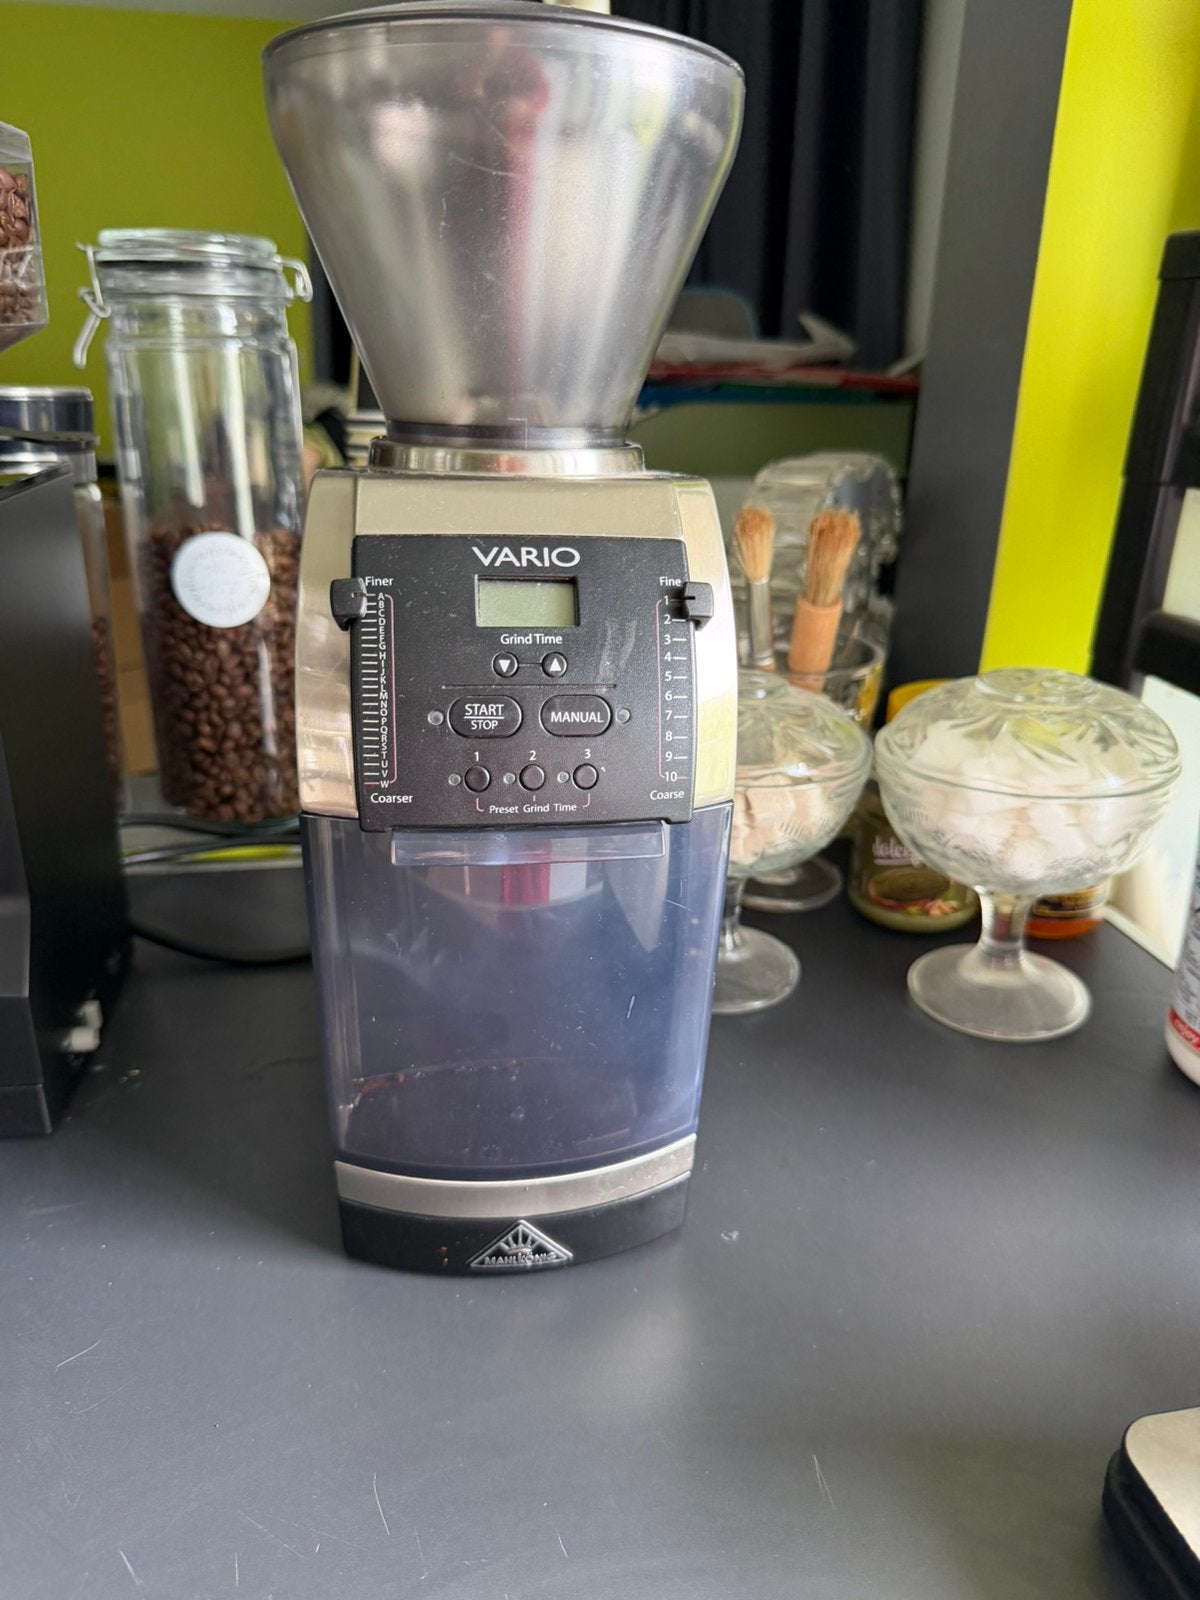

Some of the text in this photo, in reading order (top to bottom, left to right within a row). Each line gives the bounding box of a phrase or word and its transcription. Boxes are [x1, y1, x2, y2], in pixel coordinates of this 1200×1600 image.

[471, 546, 581, 568] VARIO
[365, 575, 394, 586] Finer
[659, 576, 682, 587] Fine
[378, 592, 385, 600] A
[663, 595, 669, 605] 1
[378, 609, 385, 617] C
[378, 618, 386, 626] D
[664, 614, 671, 625] 2
[379, 626, 385, 634] E
[500, 633, 563, 644] Grind Time
[664, 634, 671, 645] 3
[379, 642, 386, 650] G
[379, 652, 386, 660] H
[664, 652, 672, 662] 4
[380, 668, 385, 676] J
[664, 671, 672, 681] 5
[380, 676, 387, 684] K
[381, 684, 386, 692] L
[380, 692, 388, 700] M
[665, 691, 672, 700] 6
[380, 700, 388, 708] N
[380, 708, 388, 716] O
[464, 703, 504, 716] START
[550, 711, 604, 723] MANUAL
[665, 710, 672, 720] 7
[381, 717, 387, 725] P
[470, 720, 498, 730] STOP
[380, 726, 388, 734] Q
[381, 734, 388, 742] R
[665, 731, 672, 741] 8
[382, 751, 388, 759] T
[474, 749, 591, 761] 1 2 3
[665, 751, 673, 761] 9
[381, 760, 388, 768] U
[382, 770, 388, 778] V
[664, 771, 678, 782] 10
[380, 780, 389, 788] W
[370, 792, 413, 803] Coarser
[650, 790, 684, 800] Coarse
[489, 803, 577, 814] Preset Grind Time
